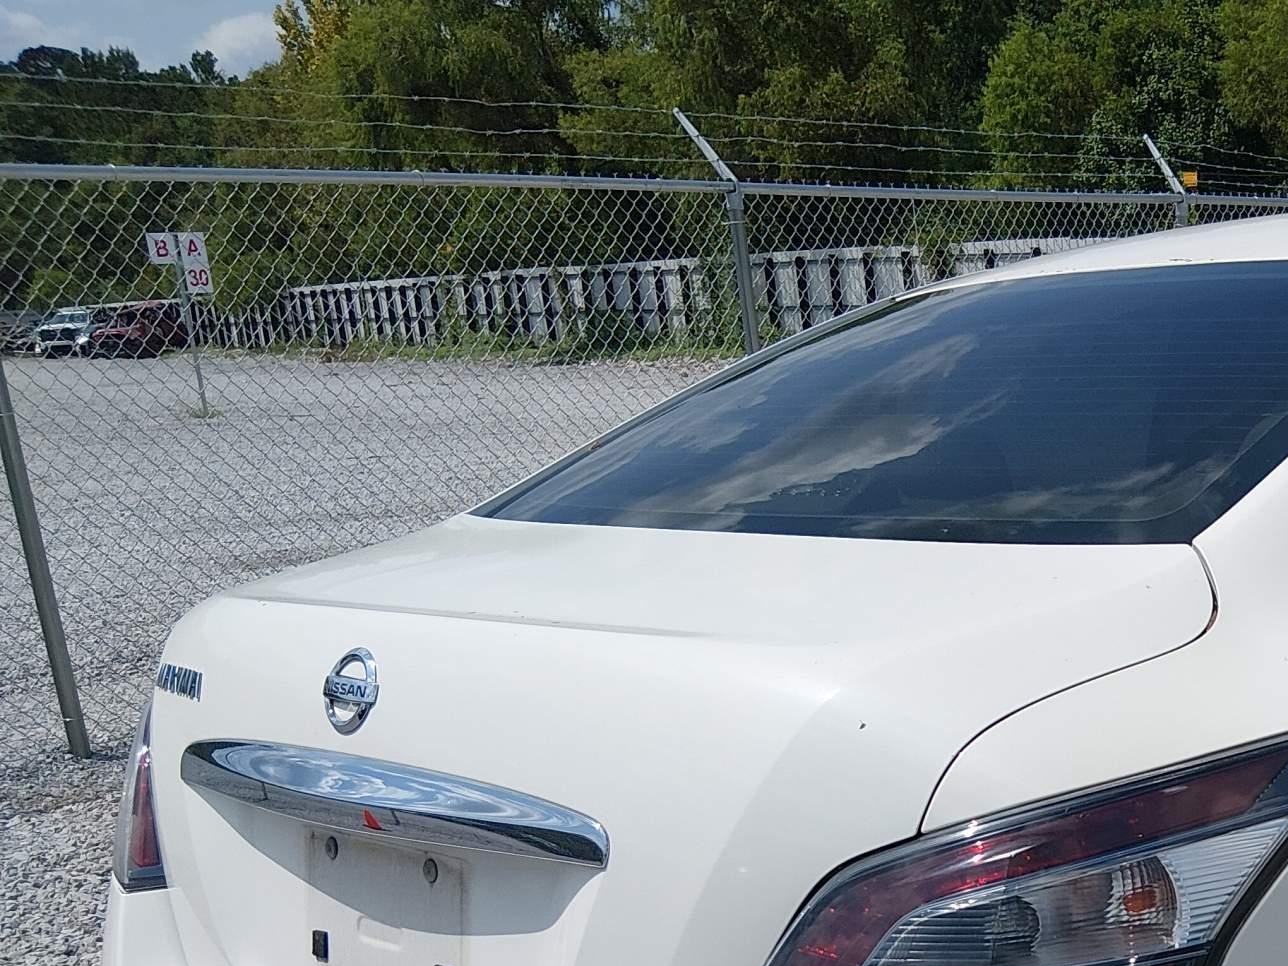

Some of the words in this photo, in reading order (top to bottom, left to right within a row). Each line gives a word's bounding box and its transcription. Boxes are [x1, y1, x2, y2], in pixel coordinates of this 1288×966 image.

[154, 239, 169, 257] B
[187, 239, 201, 257] A
[188, 269, 209, 286] 30
